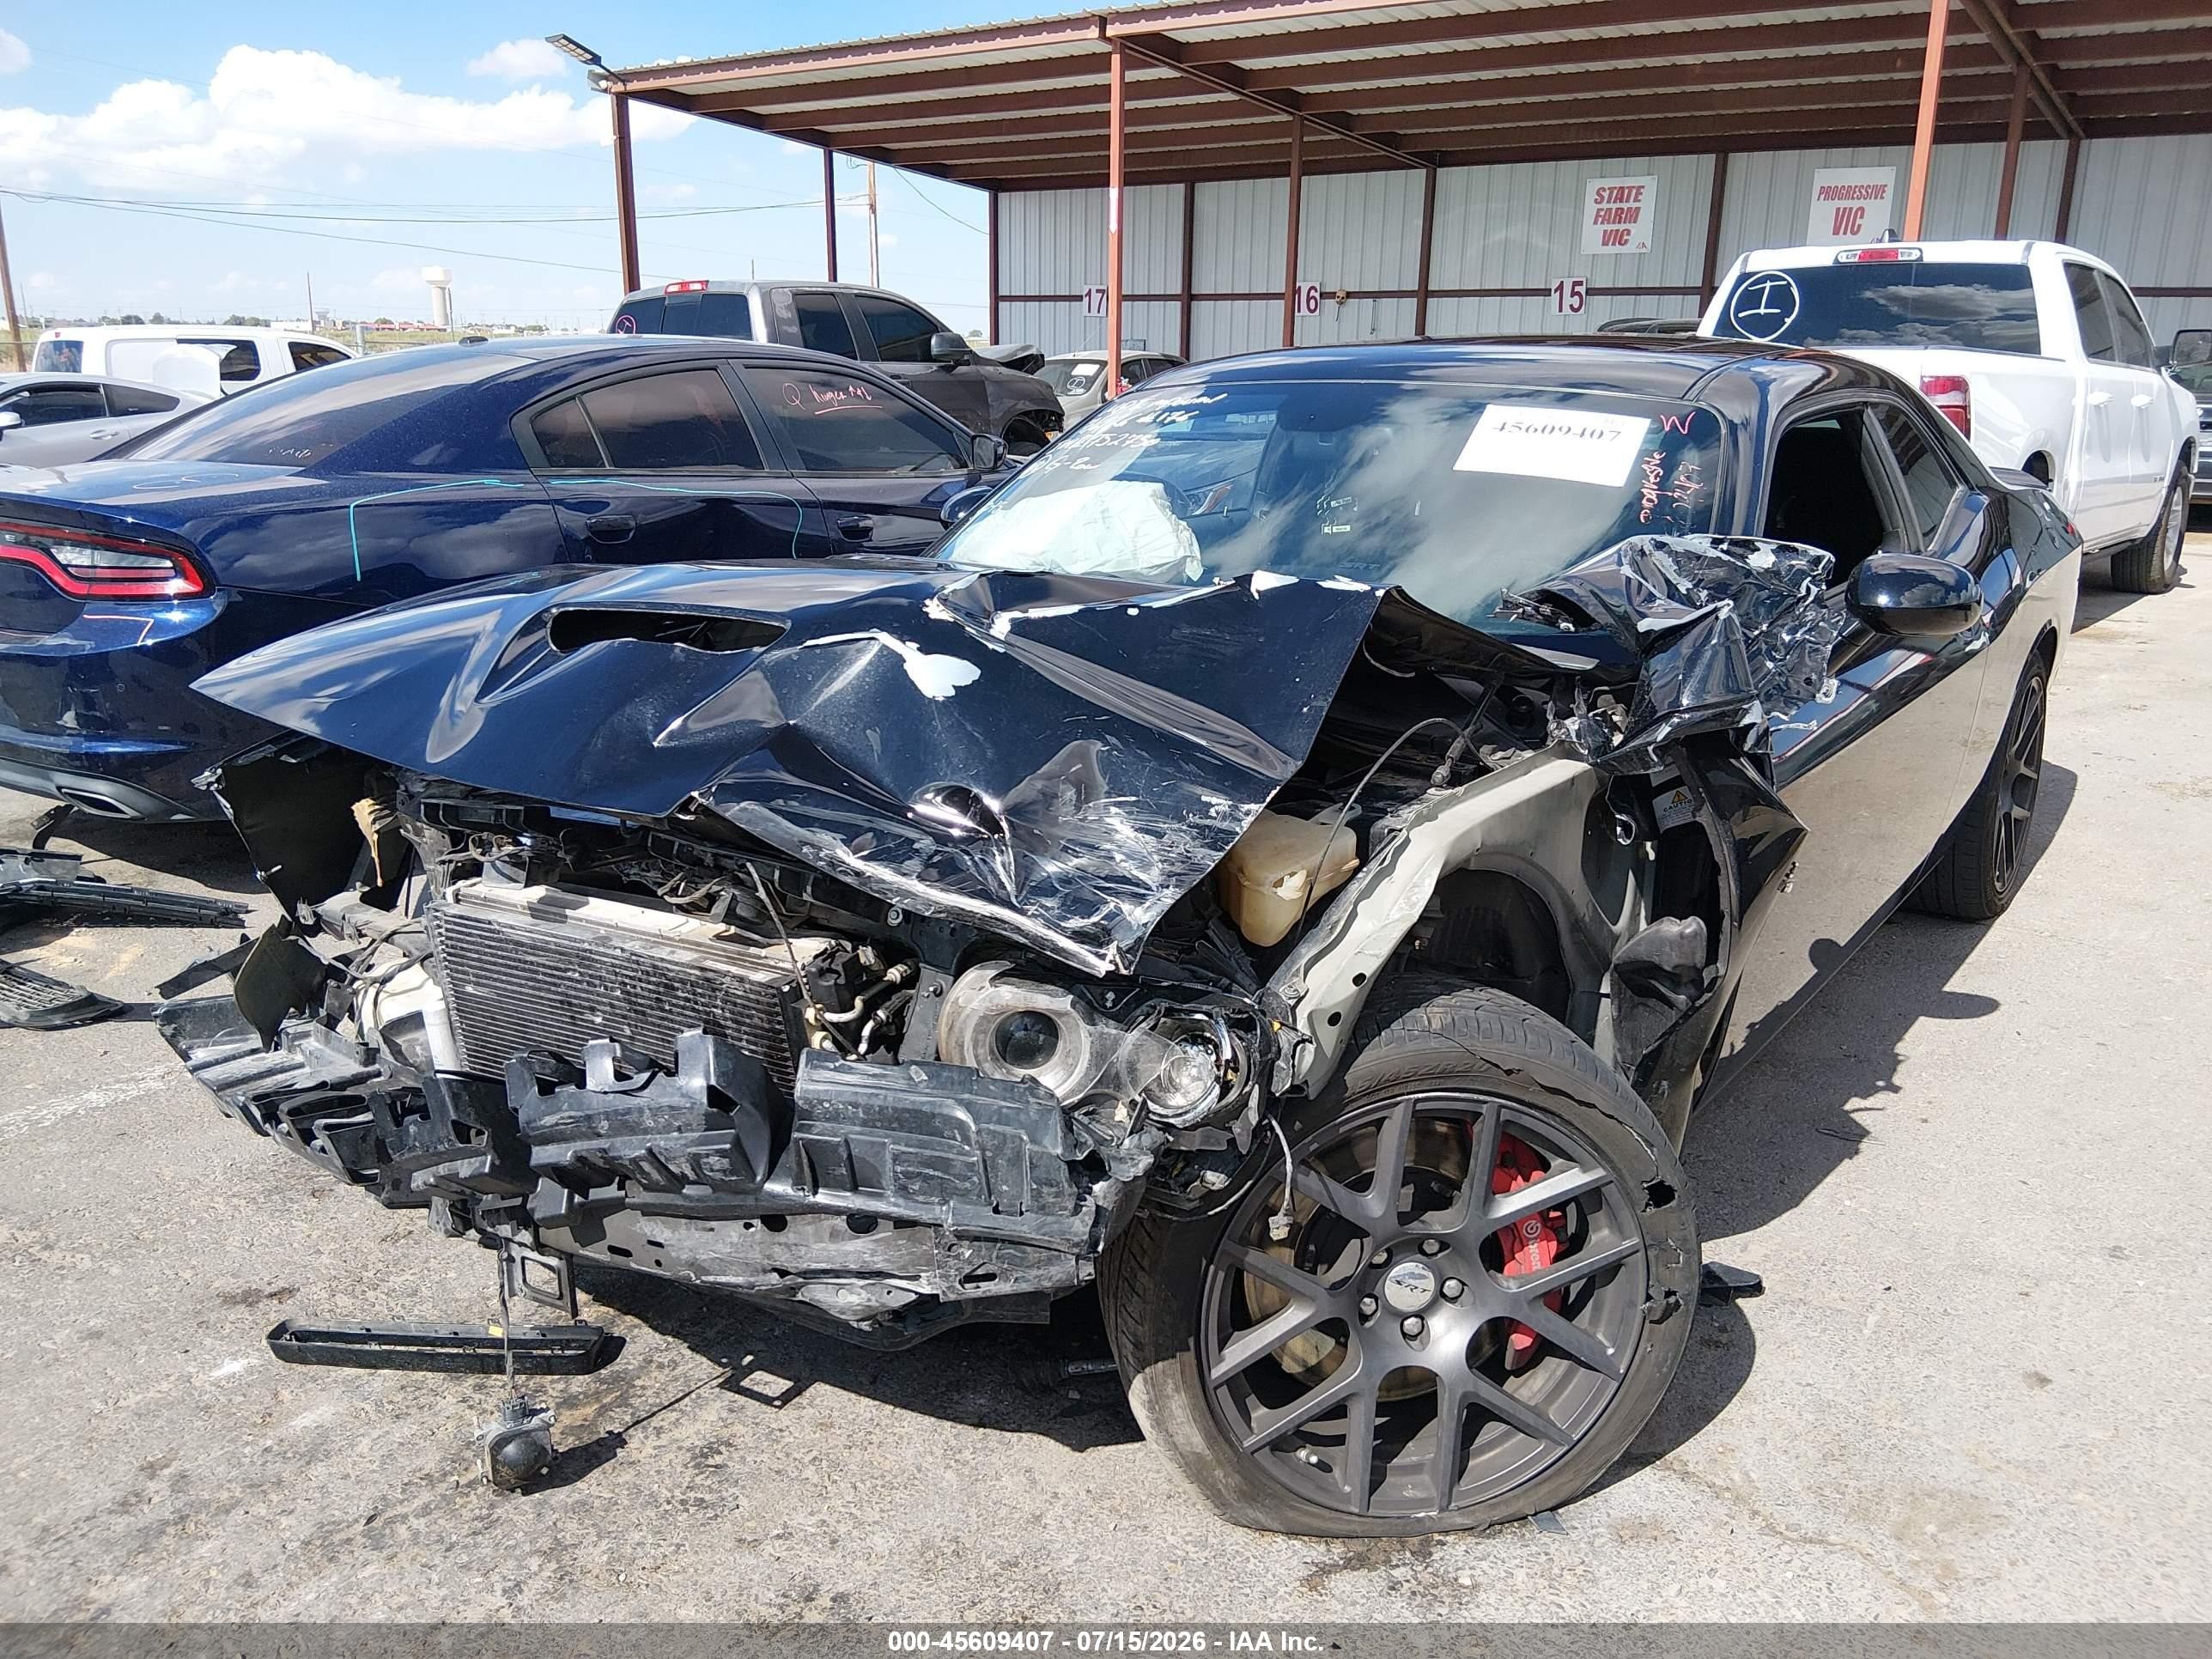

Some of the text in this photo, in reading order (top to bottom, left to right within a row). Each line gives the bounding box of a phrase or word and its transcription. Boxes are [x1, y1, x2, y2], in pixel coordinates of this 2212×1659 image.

[1594, 185, 1645, 204] STATE
[1817, 185, 1887, 201] PROGRESSIVE
[1593, 207, 1641, 225] FARM
[1832, 206, 1865, 235] VIC
[1601, 228, 1631, 246] VIC
[1085, 289, 1106, 313] 17
[1295, 285, 1318, 313] 16
[1554, 281, 1583, 313] 15
[1492, 422, 1622, 441] 45609407
[1663, 799, 1693, 812] CAUTIO
[1390, 1279, 1431, 1293] SRT
